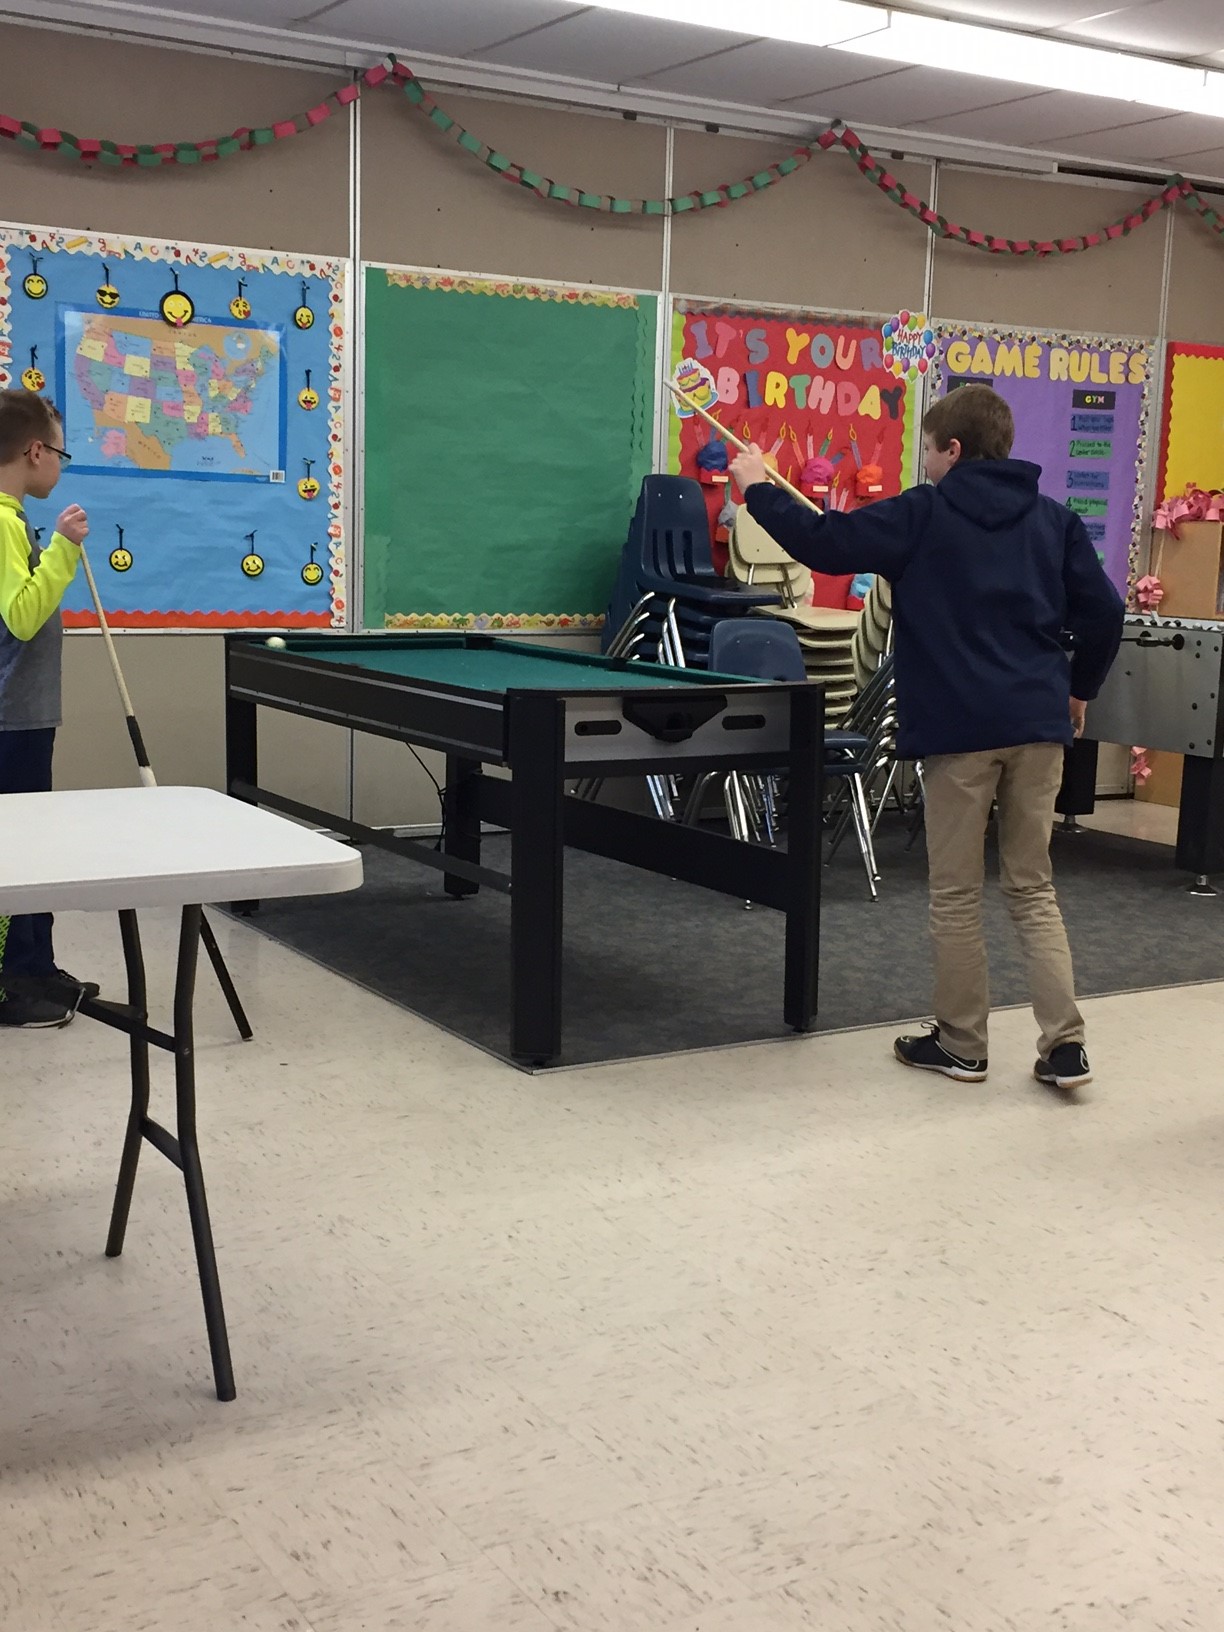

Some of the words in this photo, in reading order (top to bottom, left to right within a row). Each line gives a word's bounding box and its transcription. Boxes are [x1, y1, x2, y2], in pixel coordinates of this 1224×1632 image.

[690, 320, 770, 364] IT'S
[786, 328, 884, 371] YOUR
[897, 328, 924, 345] HAPPY
[946, 340, 1043, 378] GAME
[1049, 348, 1148, 384] RULES
[716, 366, 903, 420] BIRTHDAY
[1085, 395, 1105, 404] GYM
[1069, 440, 1076, 457] 2
[1066, 470, 1074, 488] 3
